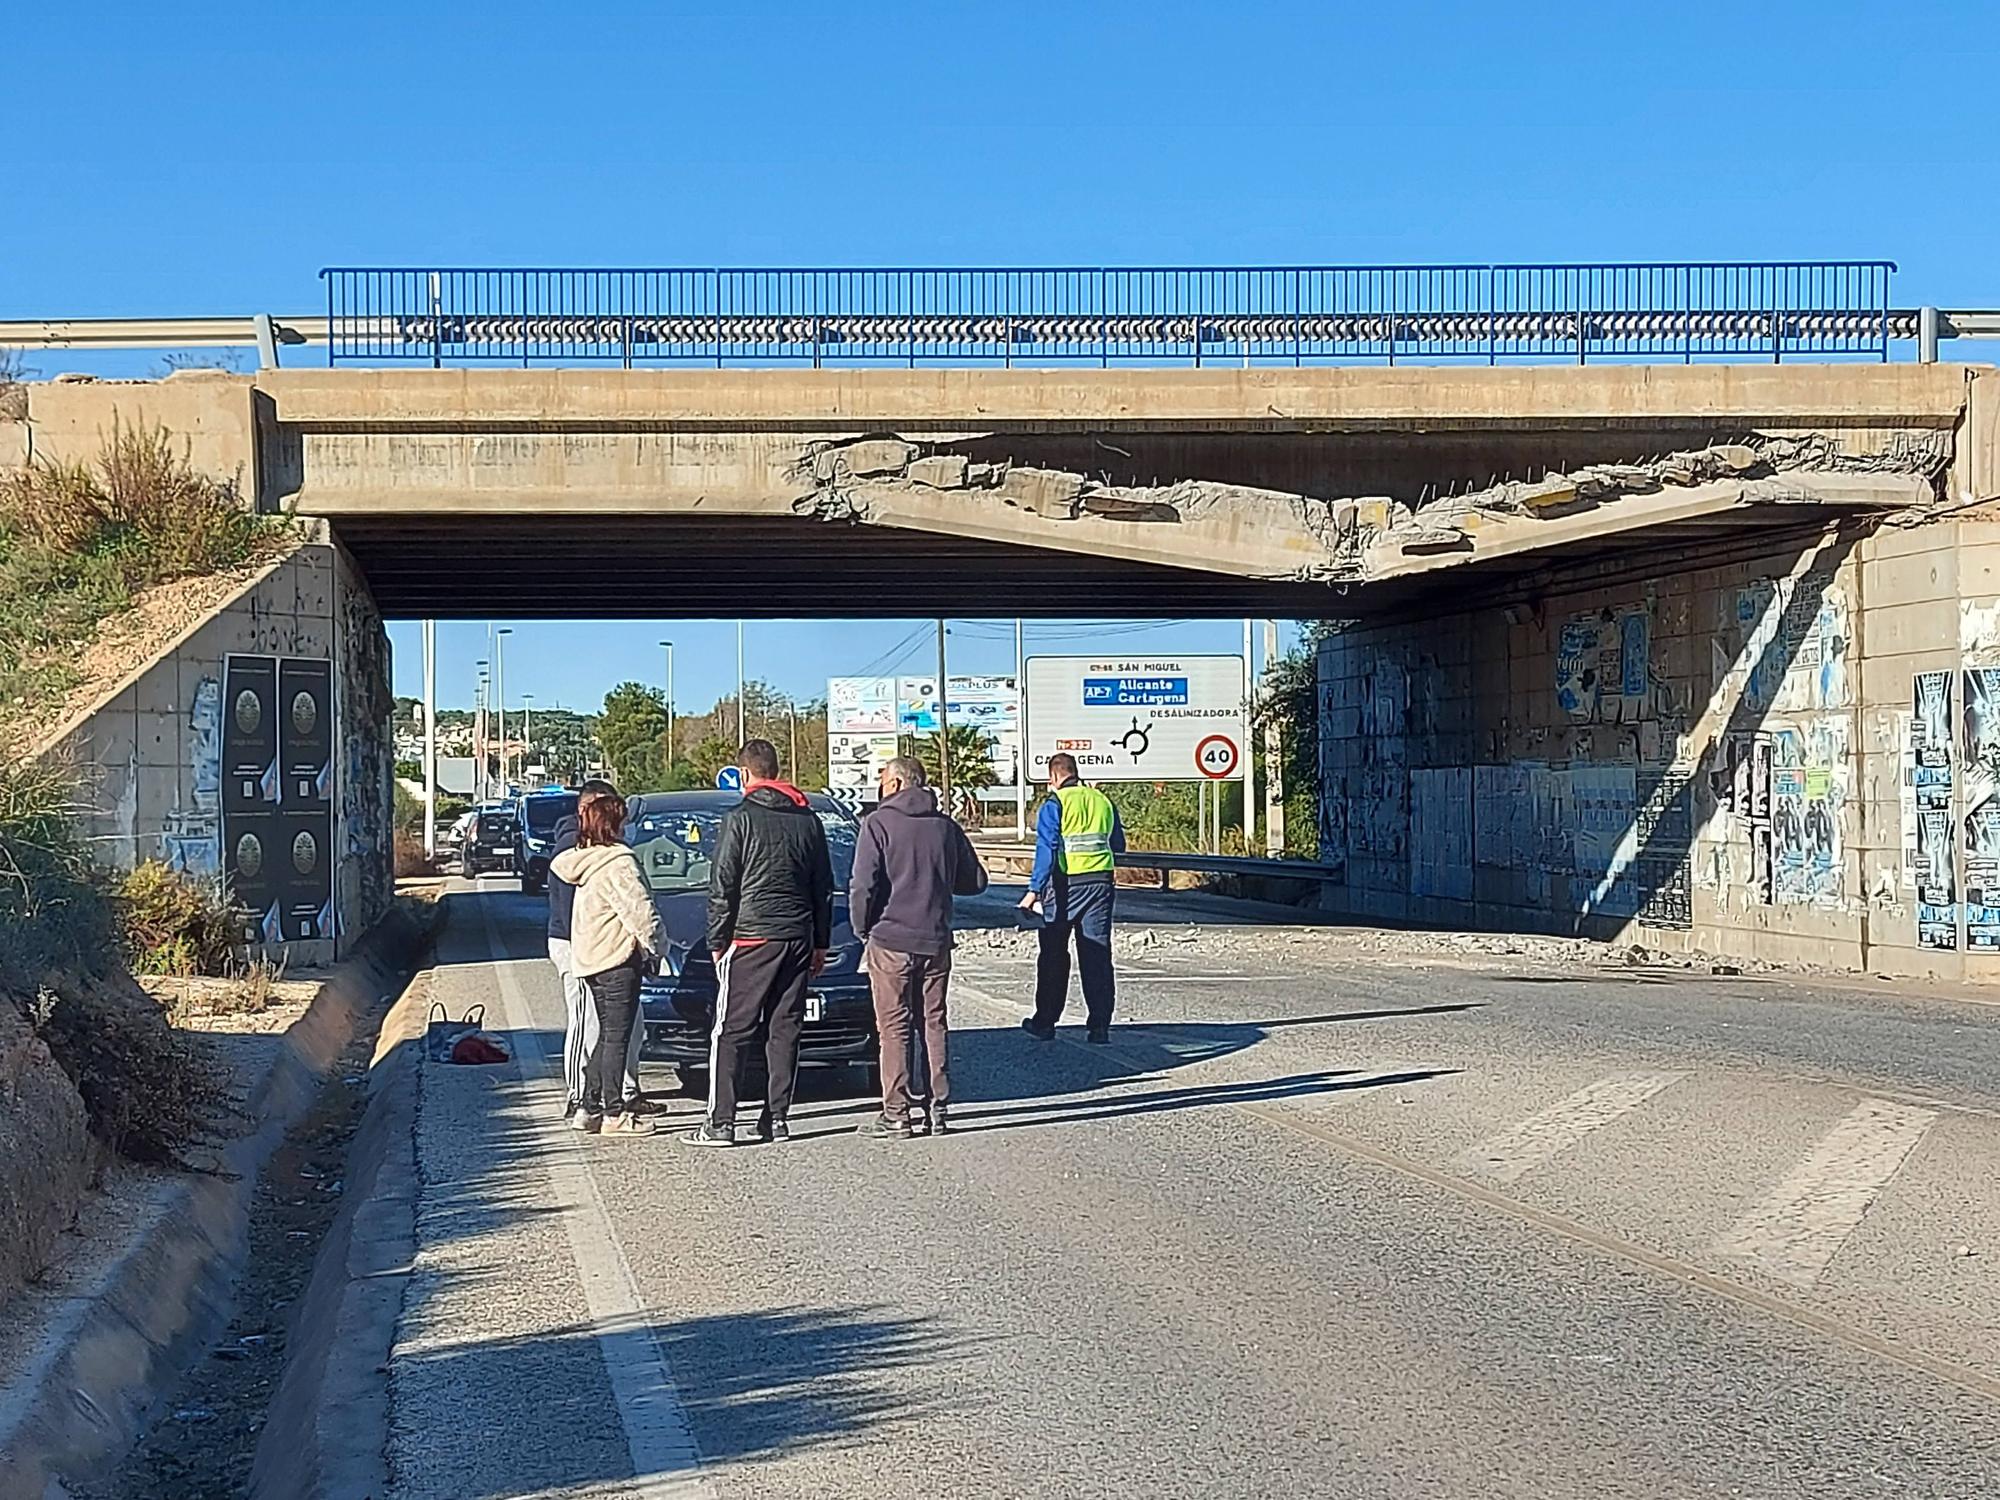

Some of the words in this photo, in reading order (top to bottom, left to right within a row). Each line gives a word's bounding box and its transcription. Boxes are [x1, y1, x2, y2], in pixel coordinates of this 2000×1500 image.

[1144, 663, 1182, 672] MIGUEL
[1118, 679, 1173, 690] Alicante
[1118, 692, 1186, 704] Cartagena
[1150, 709, 1239, 718] DESALINIZADORA
[1204, 749, 1230, 763] 40
